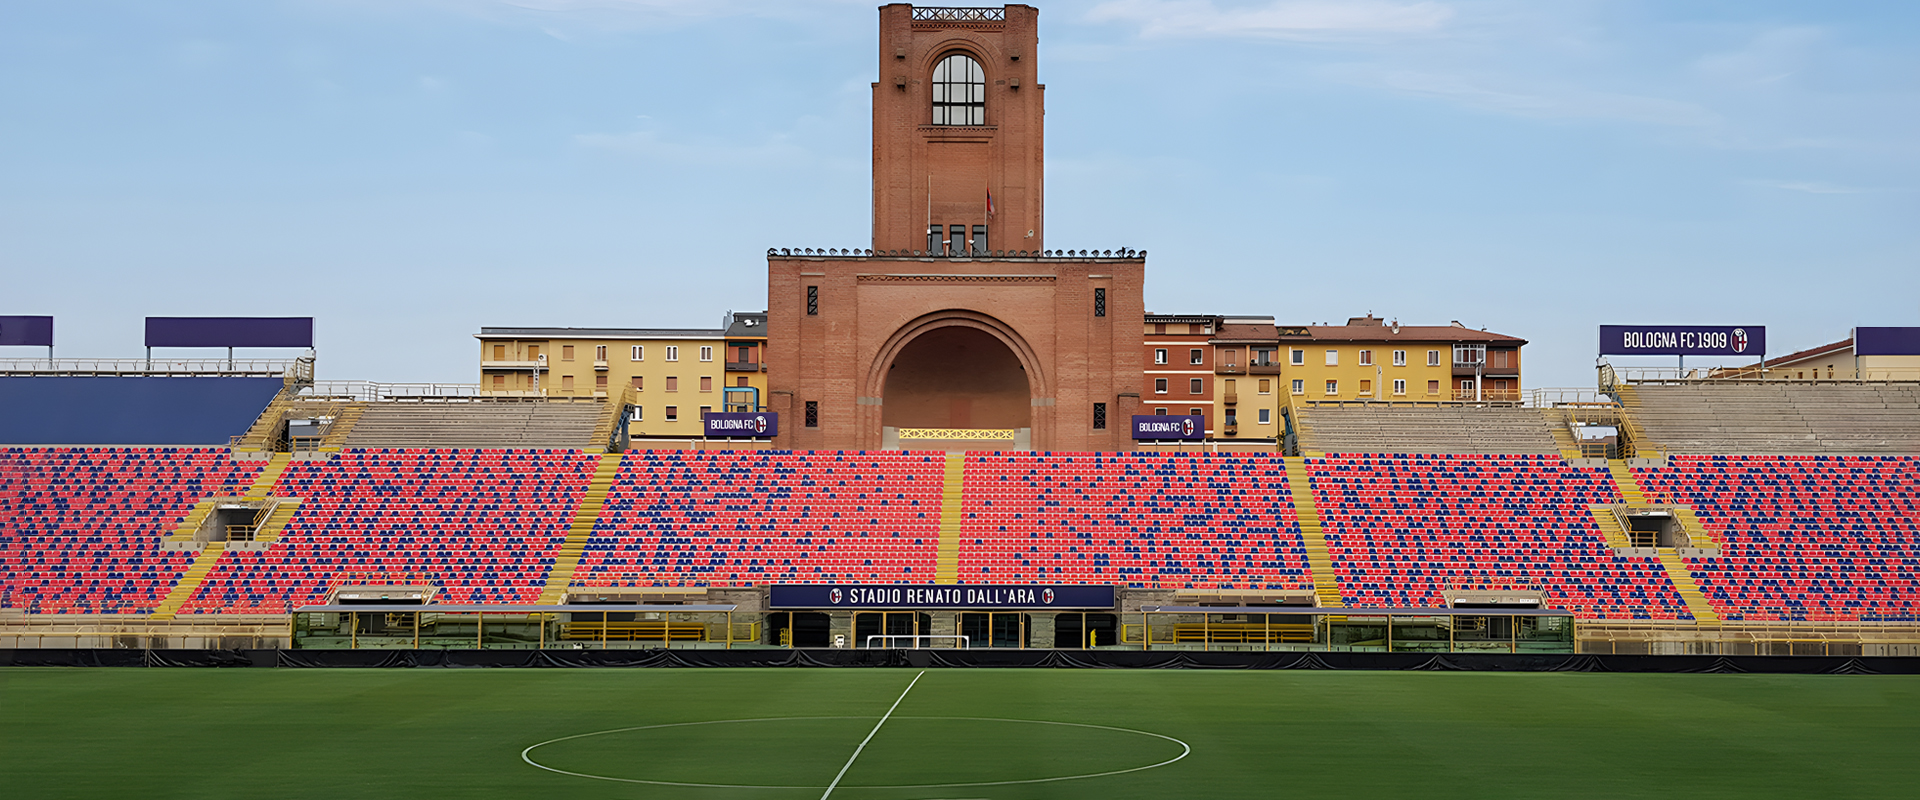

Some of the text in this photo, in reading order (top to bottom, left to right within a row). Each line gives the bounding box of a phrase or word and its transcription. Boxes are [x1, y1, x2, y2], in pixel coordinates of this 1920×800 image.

[1623, 331, 1727, 349] BOLOGNA FC 1909
[710, 419, 754, 430] BOLOGNA FC
[1139, 422, 1180, 432] BOLOGNA FC
[850, 588, 1036, 604] STADIO RENATO DALL'ARA
